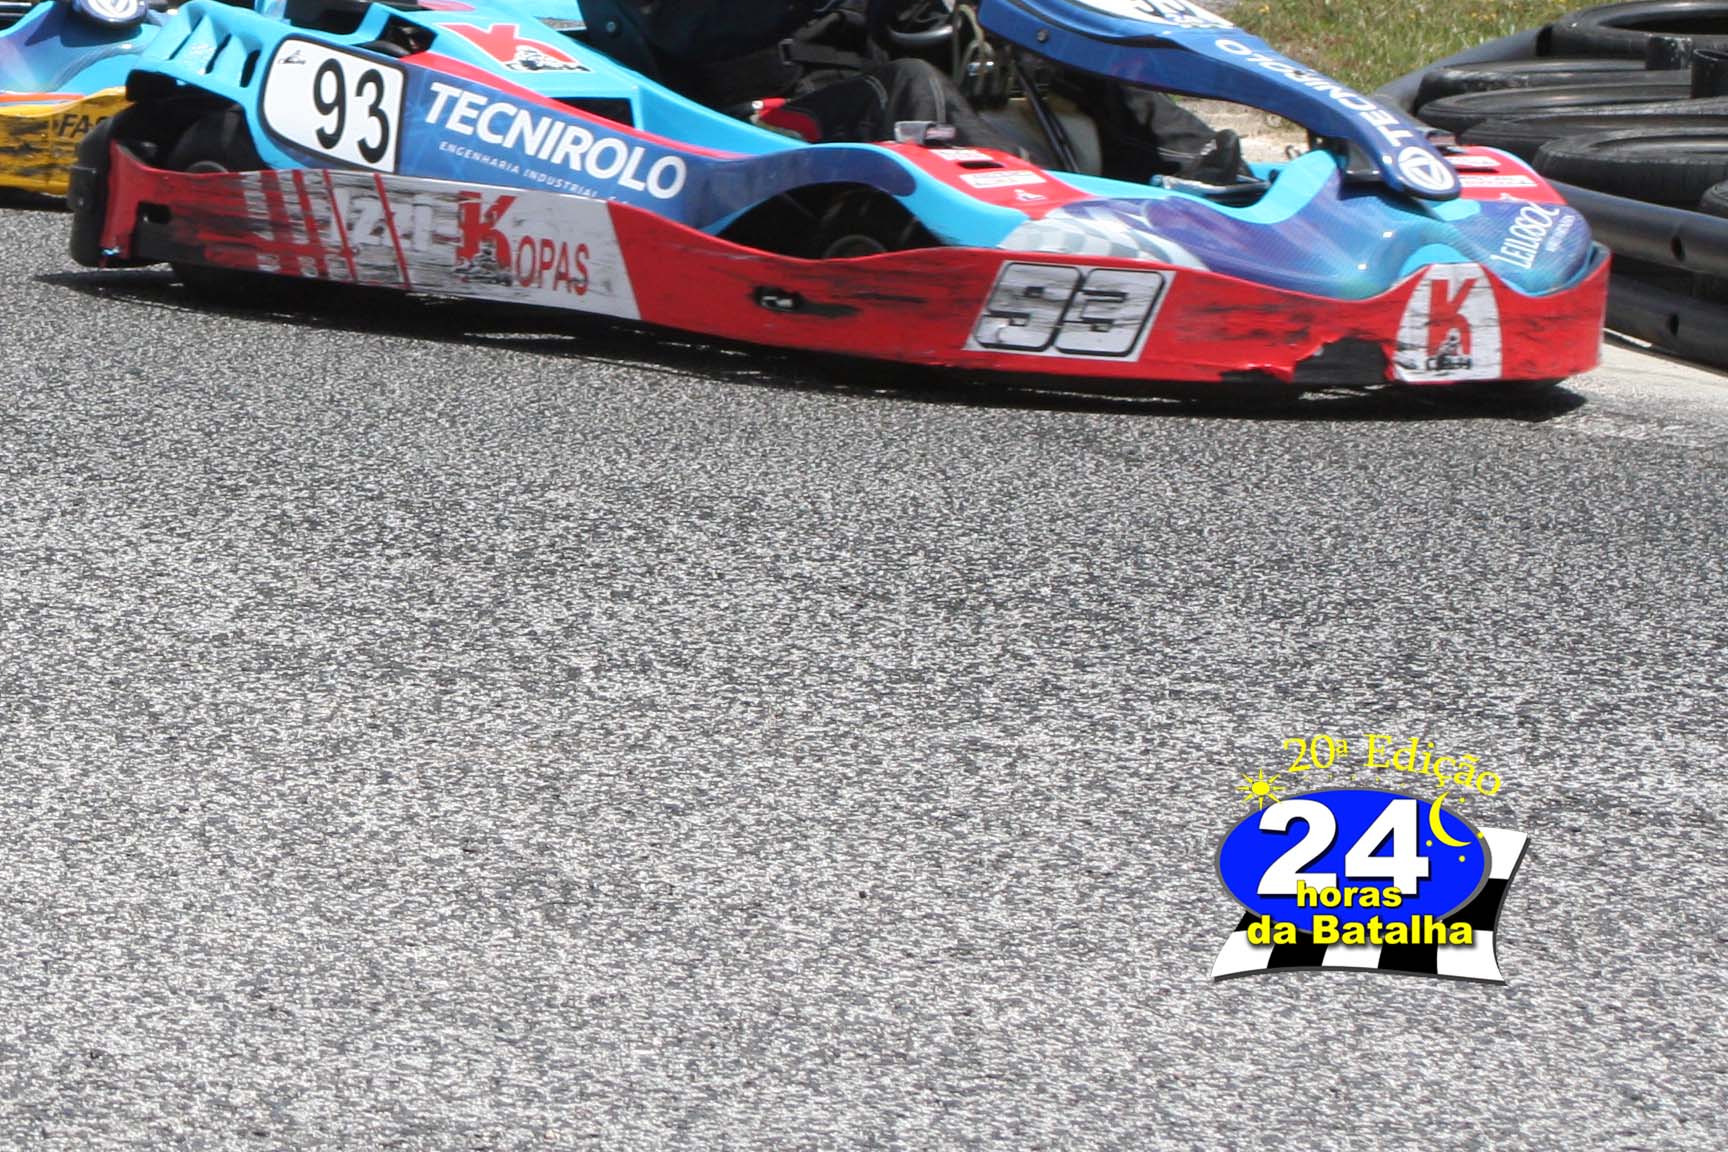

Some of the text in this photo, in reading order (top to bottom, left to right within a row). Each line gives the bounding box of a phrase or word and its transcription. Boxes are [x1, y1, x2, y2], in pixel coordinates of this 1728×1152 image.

[313, 57, 389, 165] 93
[425, 81, 688, 201] TECNIROLO
[439, 140, 521, 175] ENGENHARIA
[972, 261, 1166, 358] 93
[1426, 278, 1479, 356] K
